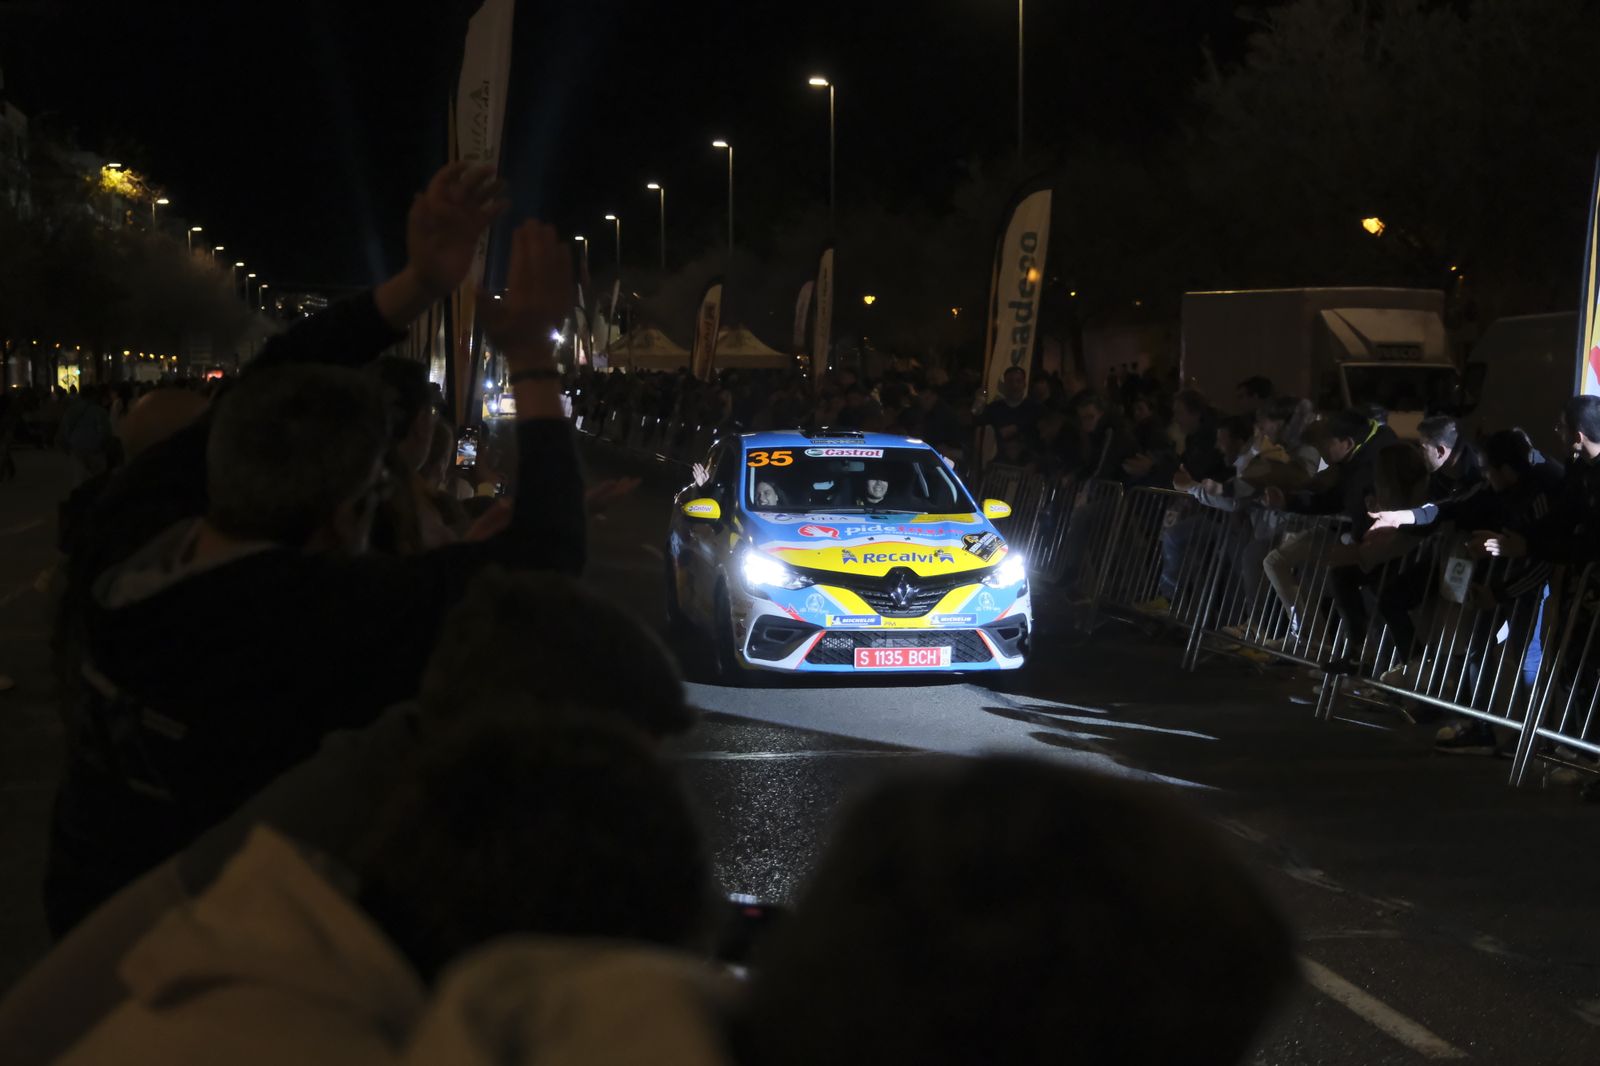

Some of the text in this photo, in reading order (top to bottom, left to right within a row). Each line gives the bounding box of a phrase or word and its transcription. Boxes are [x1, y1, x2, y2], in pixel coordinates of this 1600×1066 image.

[747, 450, 794, 467] 35
[825, 449, 881, 457] Castrol
[863, 552, 933, 563] Recalvi
[860, 652, 869, 665] S
[875, 651, 902, 665] 1135
[909, 650, 937, 664] BCH
